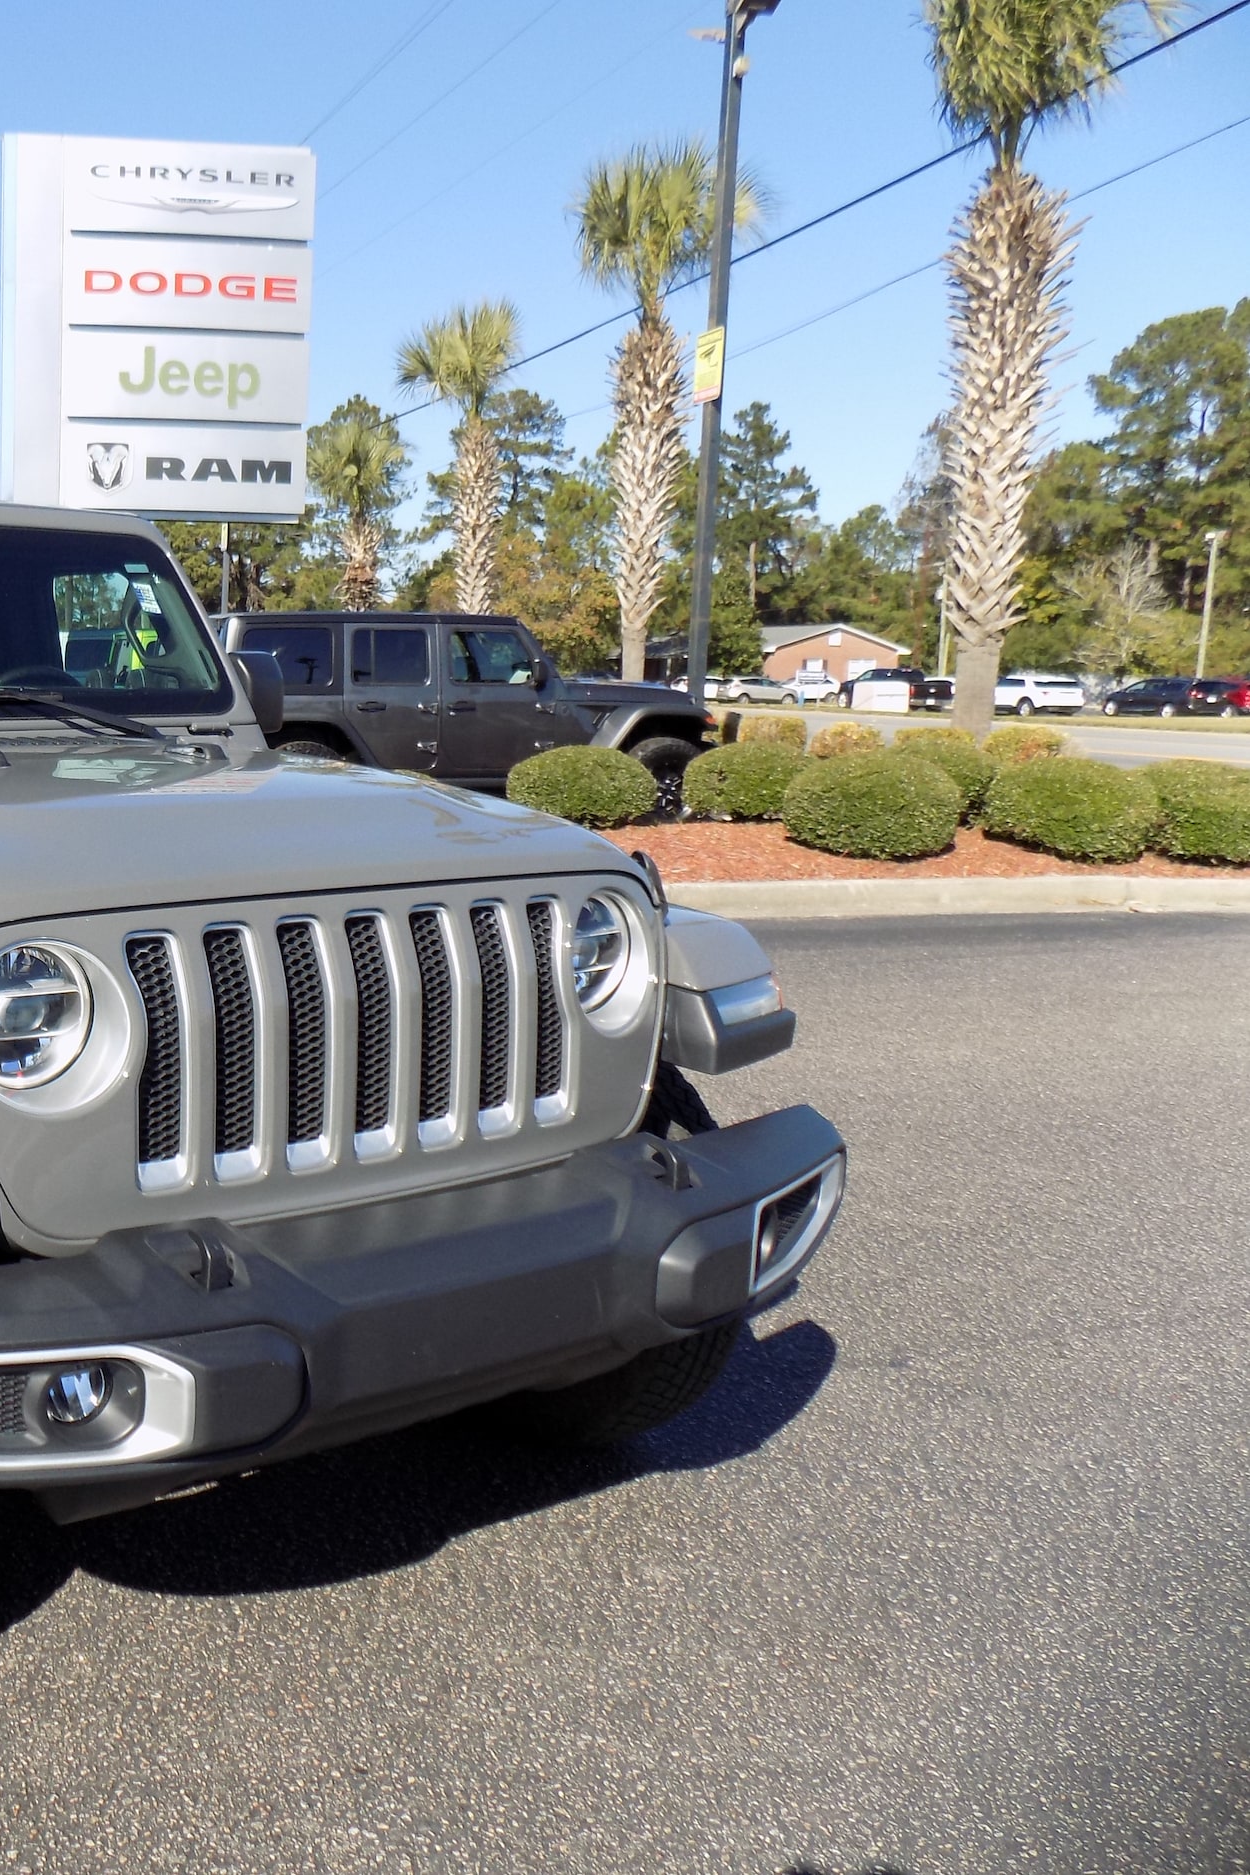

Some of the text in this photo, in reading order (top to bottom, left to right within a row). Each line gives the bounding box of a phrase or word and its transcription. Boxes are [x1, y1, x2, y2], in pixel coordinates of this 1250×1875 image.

[90, 165, 295, 187] CHRYSLER
[84, 270, 297, 303] DODGE
[119, 346, 260, 409] Jeep
[146, 457, 292, 485] RAM
